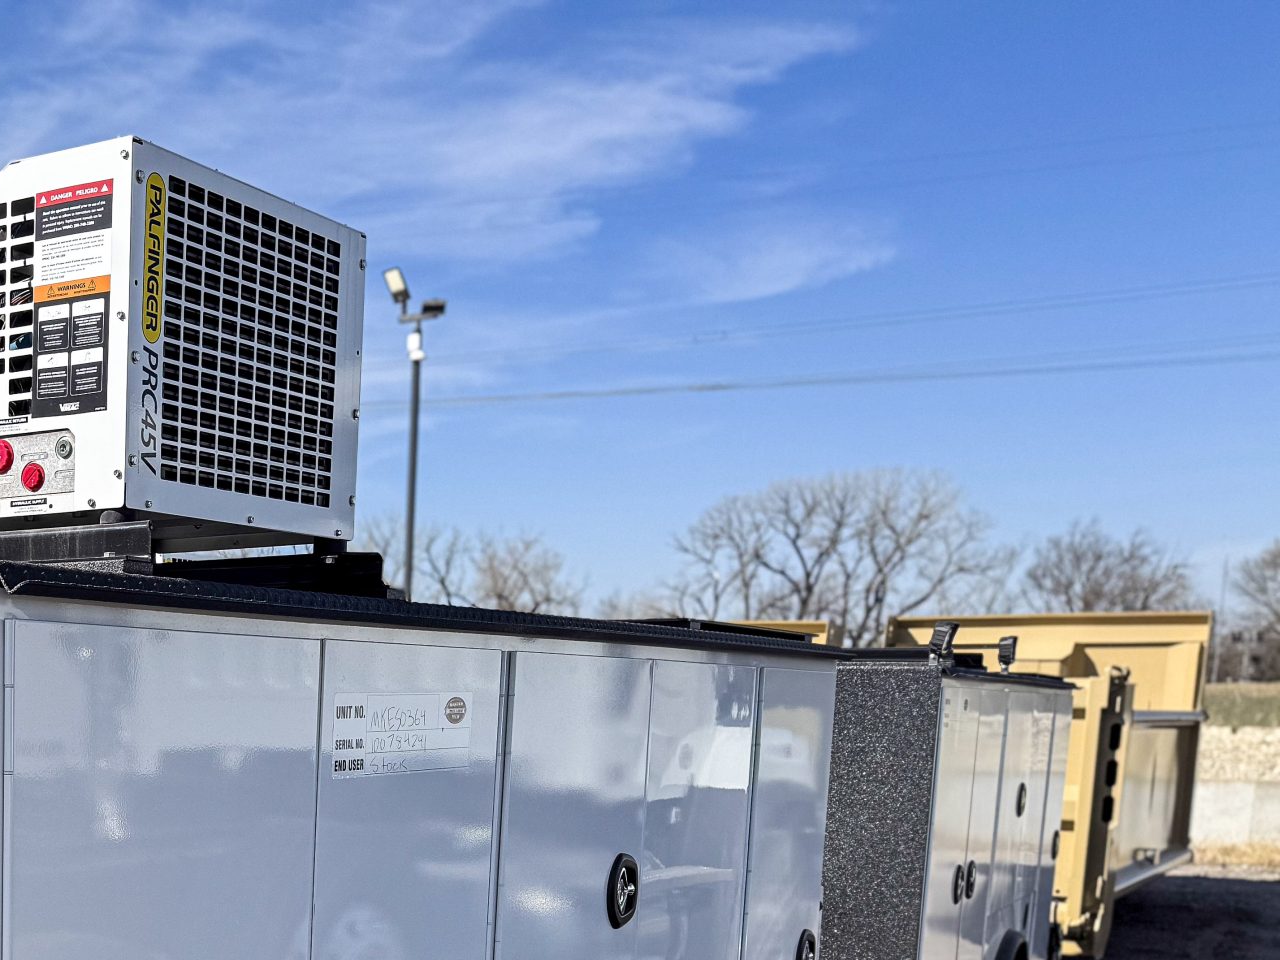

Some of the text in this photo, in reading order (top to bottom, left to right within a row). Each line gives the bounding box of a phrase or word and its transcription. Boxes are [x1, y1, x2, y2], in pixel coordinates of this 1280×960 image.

[50, 187, 99, 201] DANGER PELIGRO
[145, 183, 162, 332] PALFINGER
[57, 282, 86, 291] WARNINGS
[140, 345, 159, 476] PRC45V
[336, 705, 366, 719] UNIT NO.
[334, 738, 365, 750] SERIAL NO.
[334, 758, 364, 772] END USER
